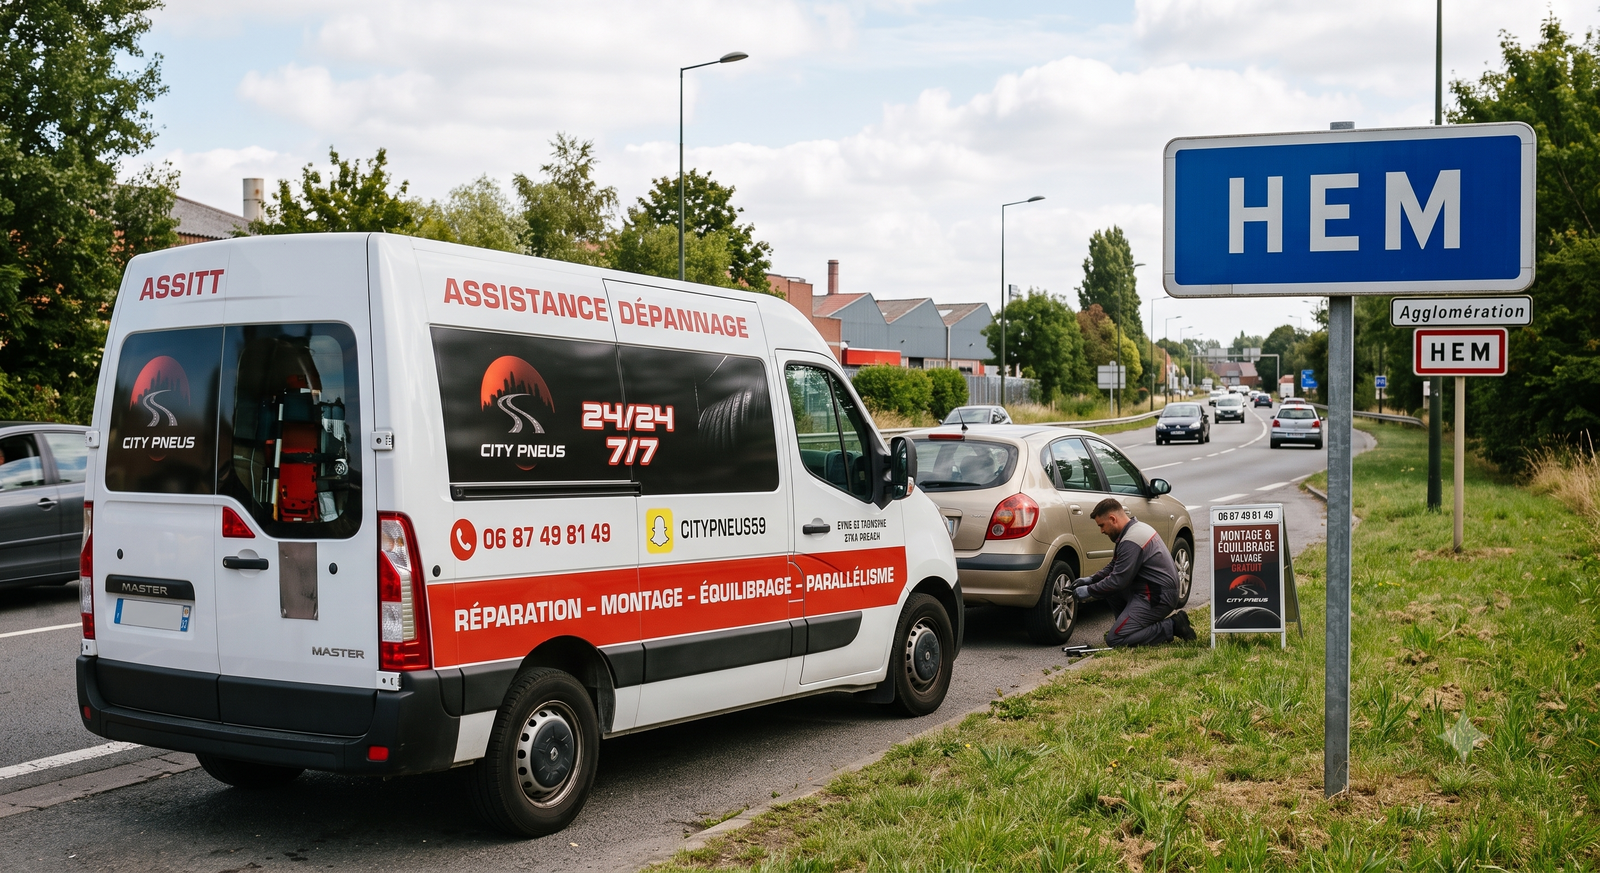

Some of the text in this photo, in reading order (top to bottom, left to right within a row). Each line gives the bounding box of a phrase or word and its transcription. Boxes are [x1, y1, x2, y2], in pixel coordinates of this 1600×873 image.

[1228, 169, 1461, 254] HEM
[139, 269, 225, 300] ASSITT
[443, 277, 749, 339] ASSISTANCE DÉPANNAGE
[1399, 304, 1525, 323] Agglomération
[1430, 342, 1490, 362] HEM
[581, 401, 675, 432] 24/24
[122, 436, 196, 449] CITY PNEUS
[480, 444, 566, 458] CITY PNEUS
[606, 436, 660, 466] 7/7
[1218, 510, 1274, 521] 06 87 49 81 49
[483, 522, 611, 549] 06 87 49 81 49
[680, 517, 766, 539] CITYPNEUS59
[1220, 529, 1272, 541] MONTAGE &
[1218, 541, 1275, 553] ÉQUILIBRAGE
[1230, 553, 1262, 563] VALVAGE
[1231, 563, 1262, 572] GRATUIT
[121, 582, 168, 596] MASTER
[454, 598, 582, 632] RÉPARATION
[601, 587, 683, 615] MONTAGE
[700, 576, 792, 605] ÉQUILIBRAGE
[806, 566, 895, 592] PARALLÉLISME
[312, 646, 365, 660] MASTER
